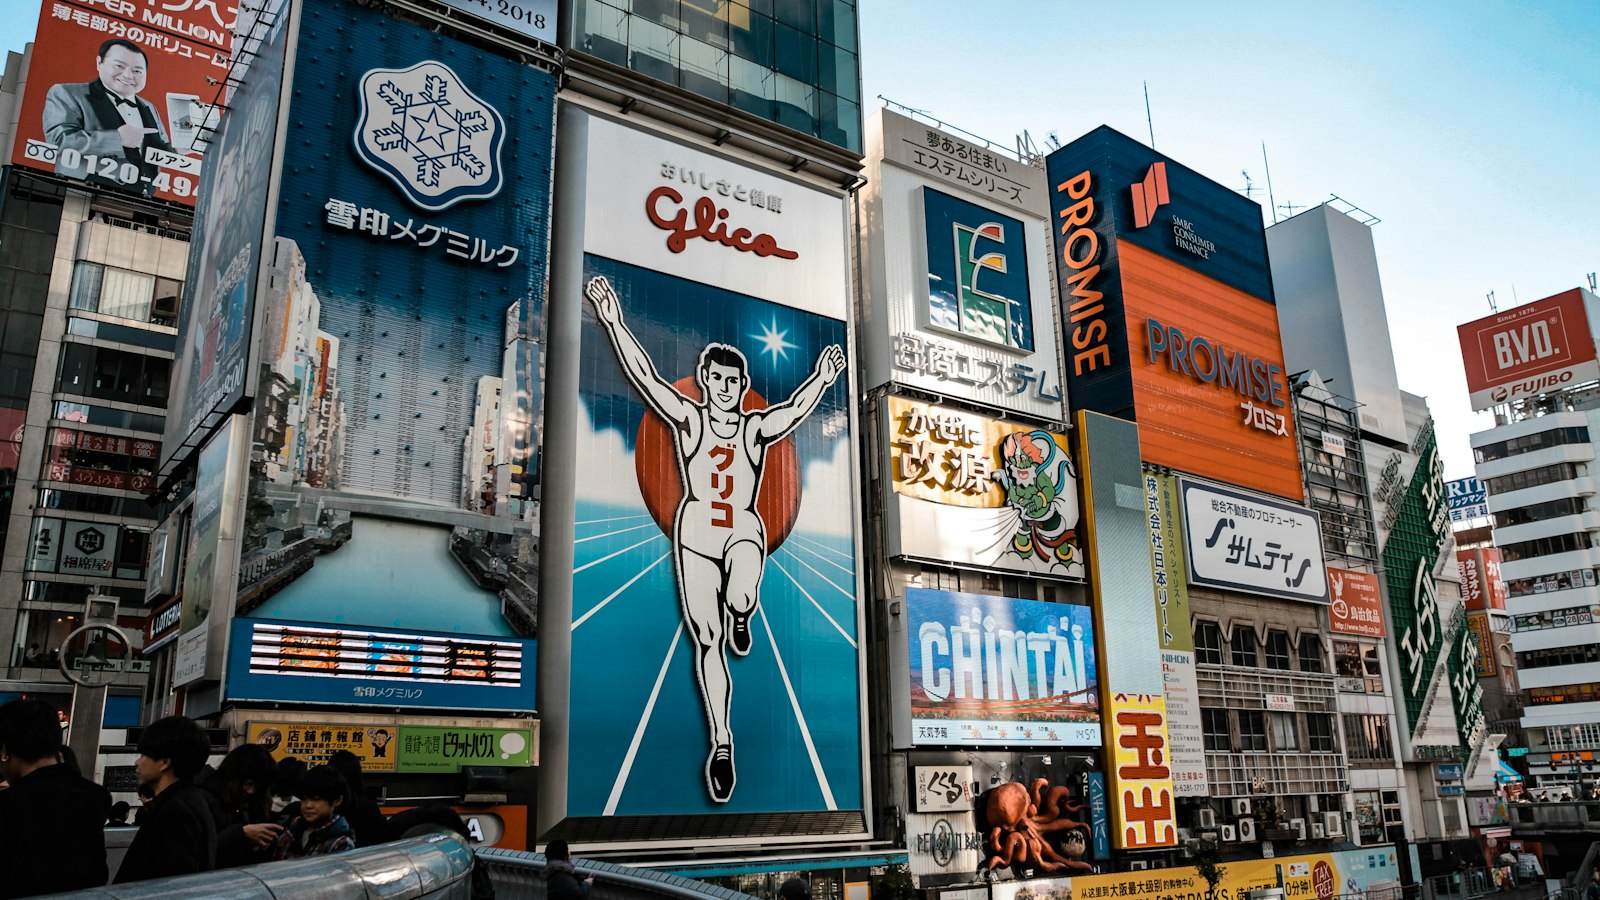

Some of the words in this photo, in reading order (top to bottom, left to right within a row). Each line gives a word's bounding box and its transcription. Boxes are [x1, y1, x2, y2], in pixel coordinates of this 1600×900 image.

[142, 9, 223, 45] MILLION
[497, 0, 545, 30] 2018
[149, 152, 192, 169] ルアン
[926, 130, 1008, 174] 夢ある住まい
[661, 161, 783, 214] おいしさと健康
[914, 150, 1023, 204] エステムシリーズ
[325, 198, 519, 267] 雪印メグミルク
[646, 186, 799, 260] Glico
[1172, 214, 1194, 233] SMBC
[1173, 226, 1217, 254] CONSUMER
[1175, 238, 1210, 260] FINANCE
[1058, 170, 1111, 377] PROMISE
[1497, 313, 1517, 324] Since
[892, 331, 1063, 403] 日商エステム
[1146, 317, 1287, 408] PROMISE
[1511, 371, 1573, 396] FUJIBO
[904, 407, 983, 446] かぜに
[1240, 400, 1289, 438] プロミス
[898, 438, 995, 495] 改源
[708, 443, 737, 529] グリコ
[1211, 498, 1303, 529] 総合不動産のプロデューサー
[1146, 475, 1173, 645] 株式会社日本リート
[1466, 559, 1481, 600] カラオケ
[155, 602, 181, 634] LOTTERIA
[1162, 654, 1190, 664] NIHON
[353, 686, 423, 699] 雪印メグミルク
[288, 730, 364, 743] 店舗情報館
[443, 732, 495, 758] ピタットハウス
[919, 726, 948, 739] 天気予報
[1116, 711, 1176, 848] 玉出
[1173, 783, 1205, 791] 6-6281-1717
[1314, 864, 1330, 883] TAX
[1315, 878, 1335, 899] FREE!
